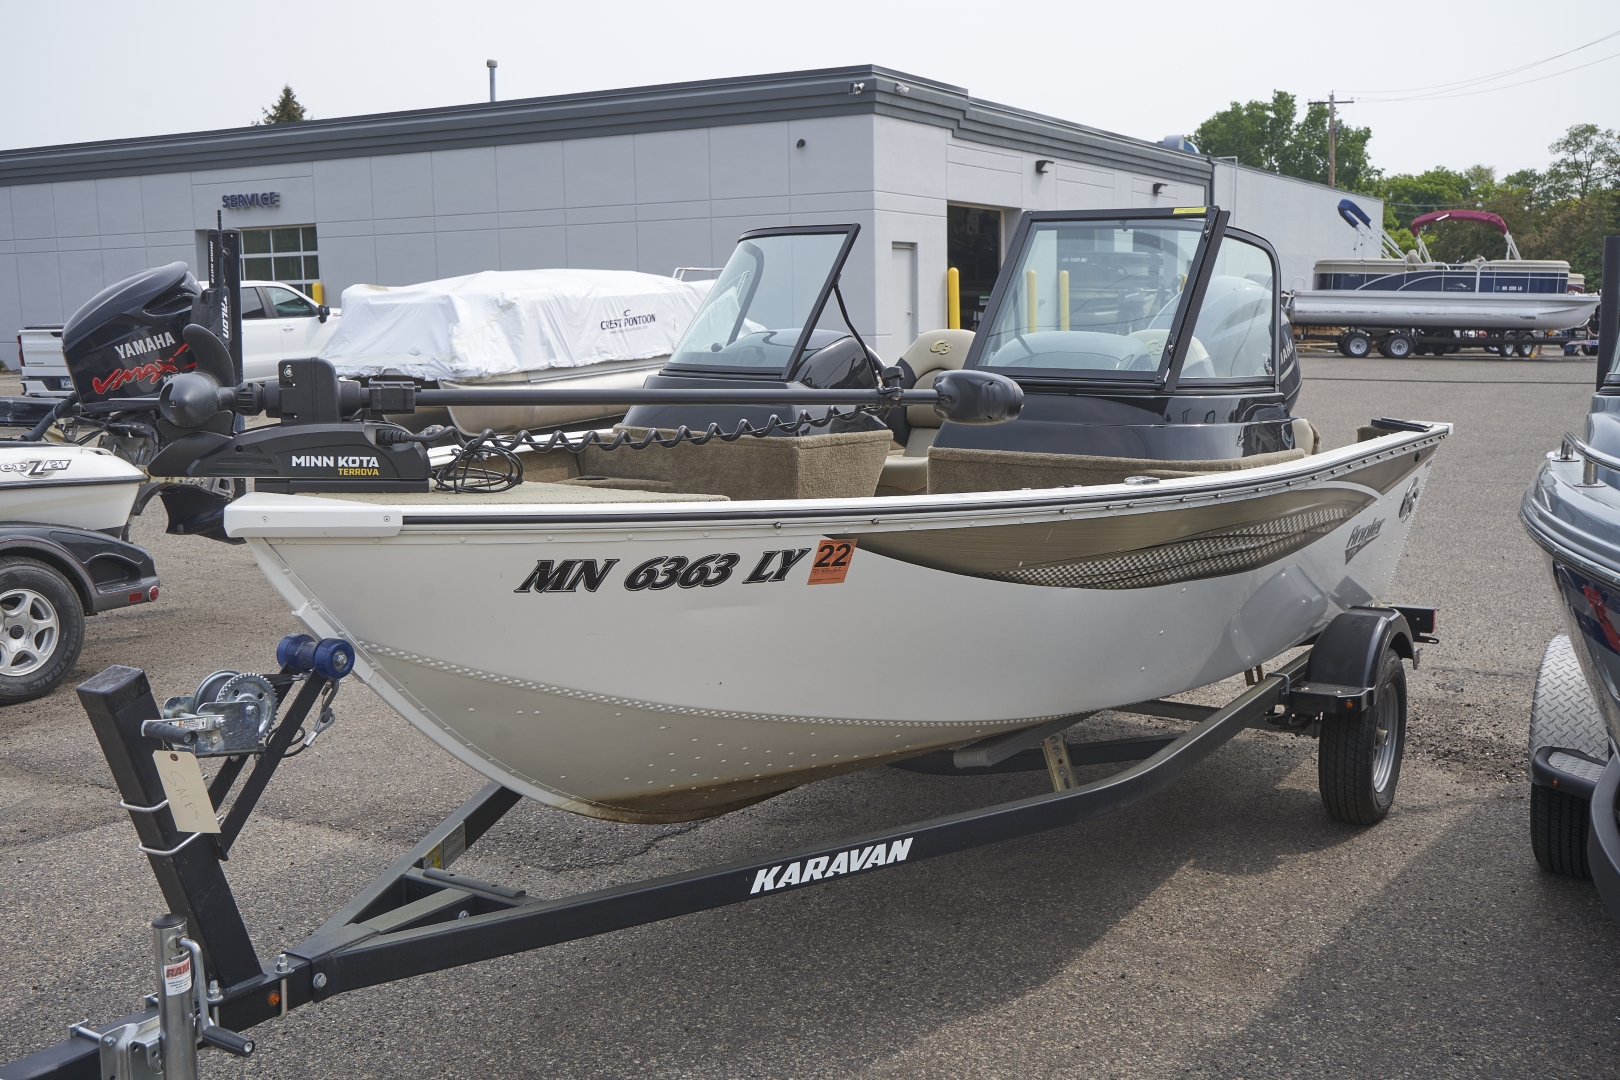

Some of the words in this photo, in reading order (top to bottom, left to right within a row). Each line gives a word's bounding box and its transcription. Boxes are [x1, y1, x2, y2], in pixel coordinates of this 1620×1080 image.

[221, 191, 281, 209] SERVICE
[600, 318, 622, 331] CREST
[624, 313, 656, 327] PONTOON
[114, 331, 176, 359] YAMAHA
[291, 455, 335, 468] MINN
[337, 456, 380, 468] KOTA
[337, 468, 380, 476] TERROVA
[813, 543, 852, 568] 22
[514, 558, 620, 593] MN
[623, 552, 741, 592] 6363
[741, 547, 812, 585] LY
[749, 837, 914, 895] KARAVAN
